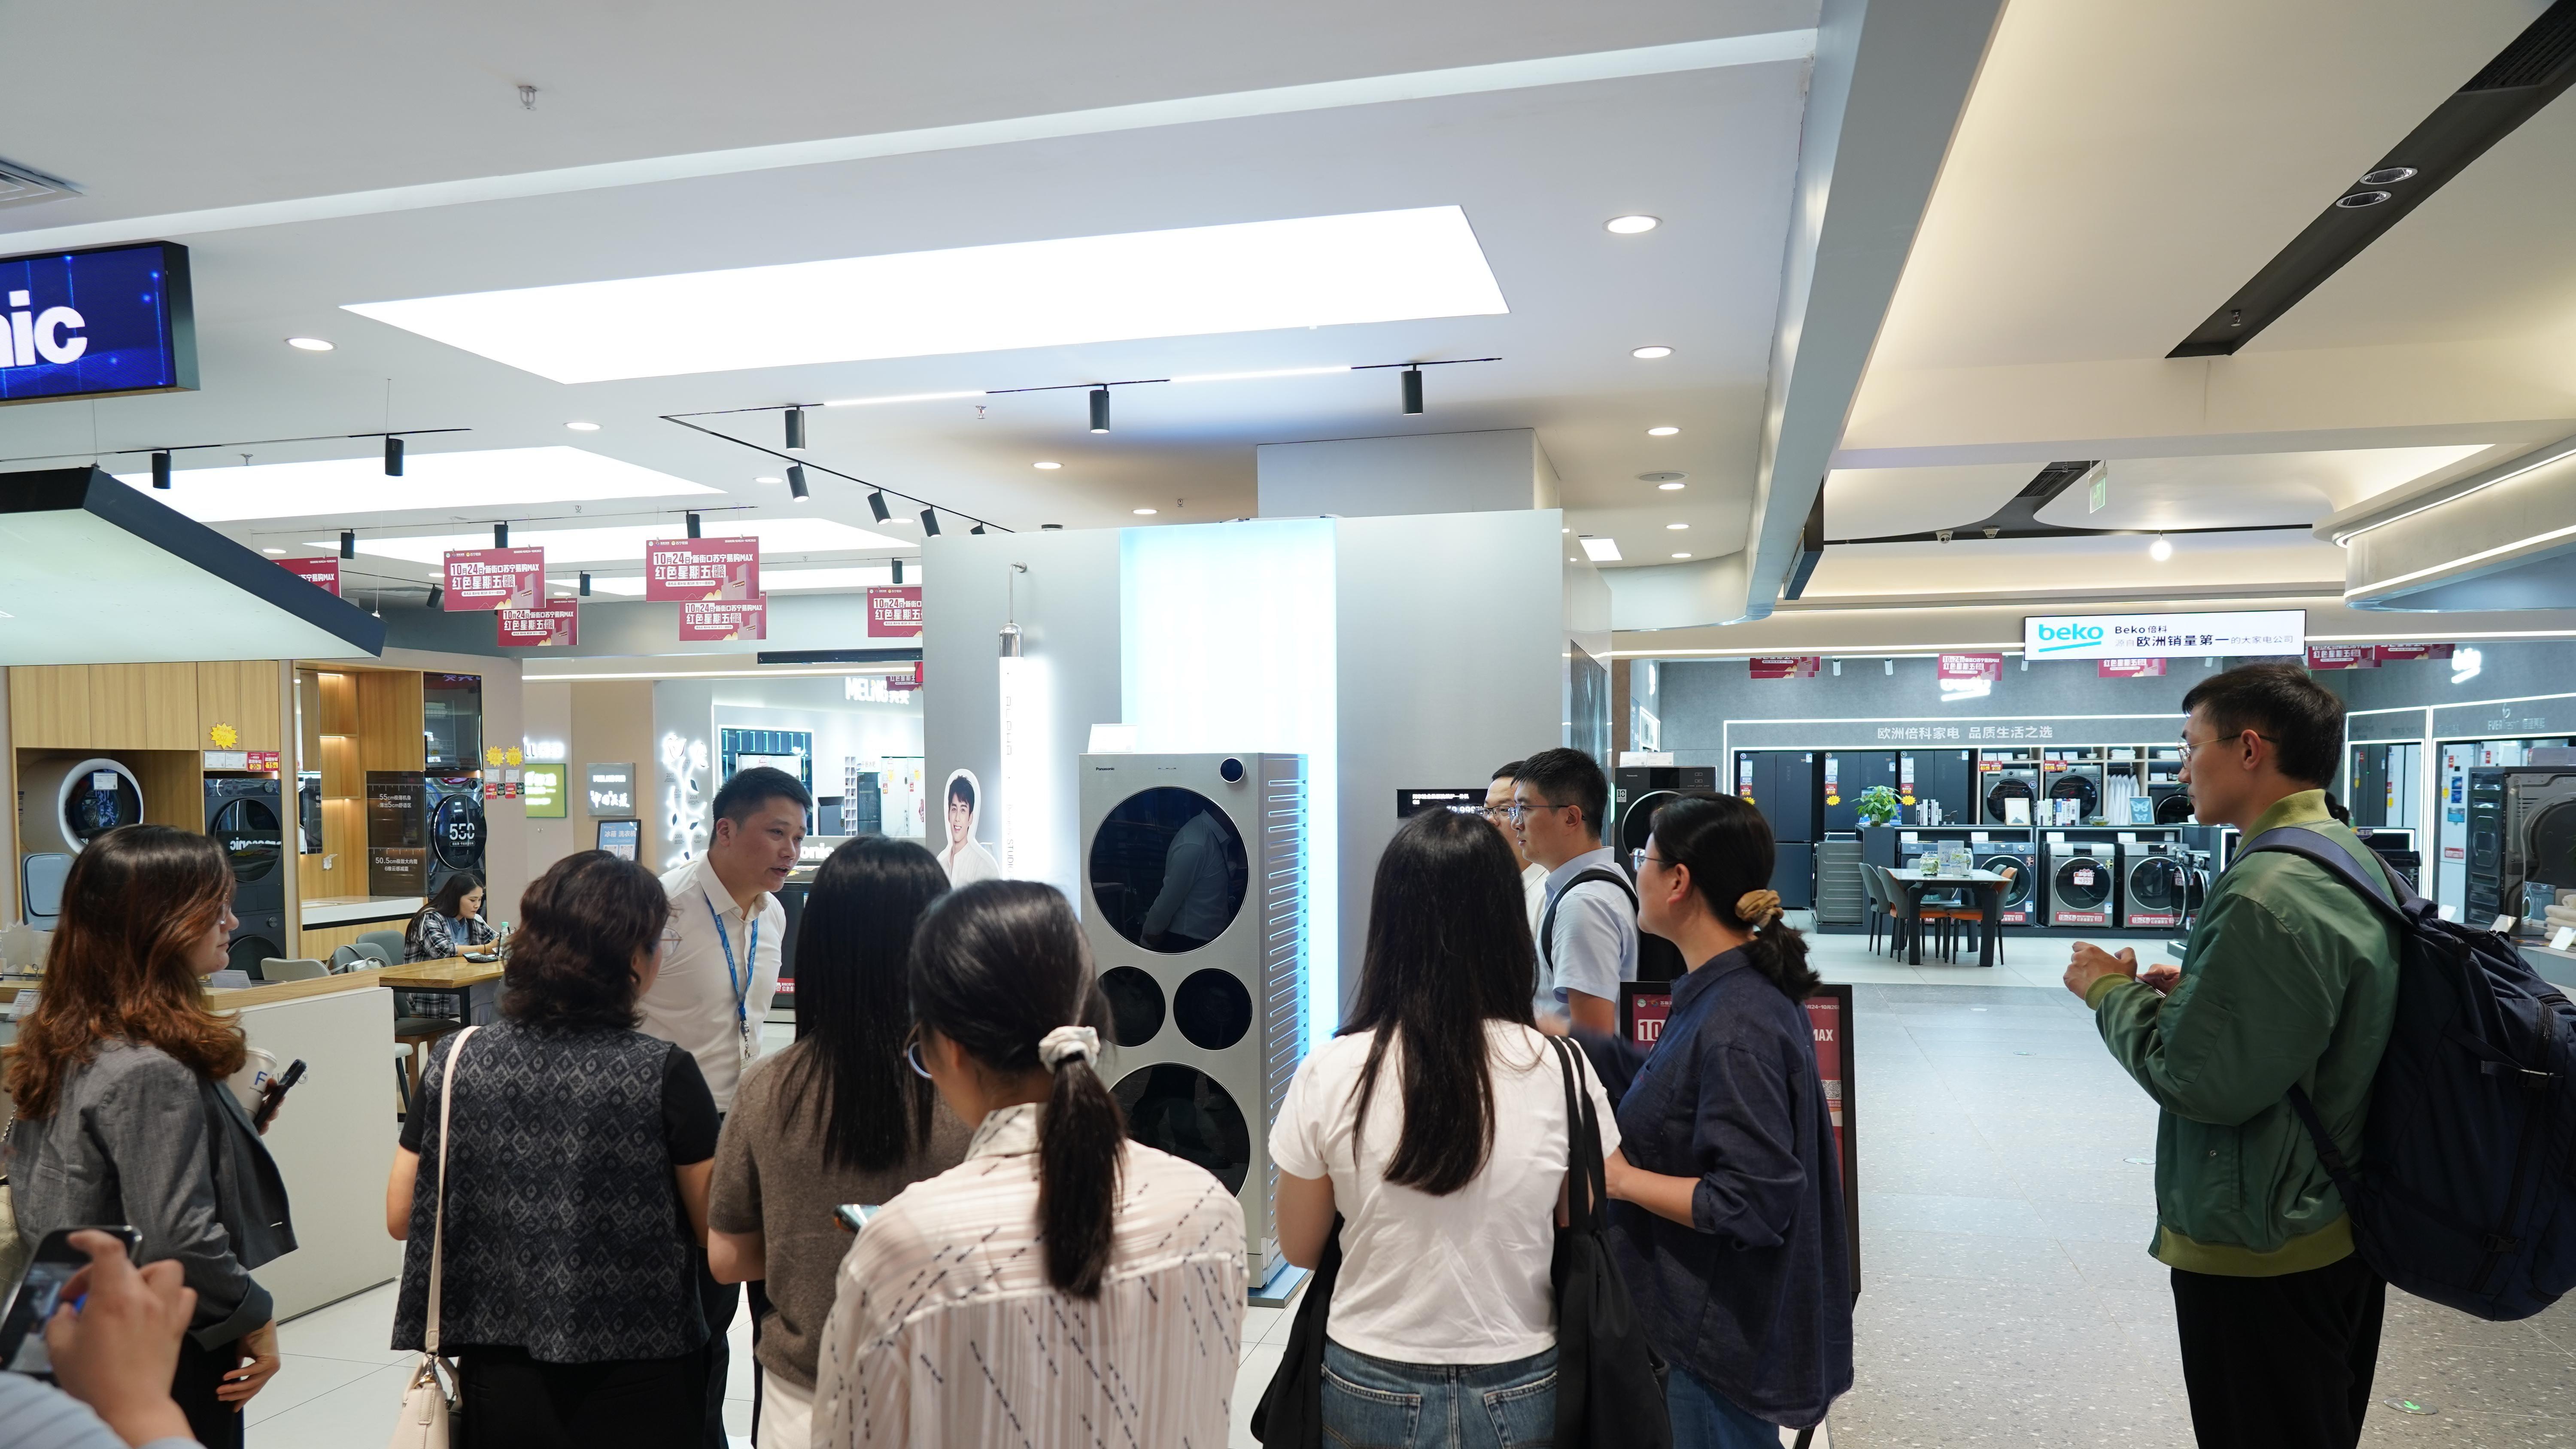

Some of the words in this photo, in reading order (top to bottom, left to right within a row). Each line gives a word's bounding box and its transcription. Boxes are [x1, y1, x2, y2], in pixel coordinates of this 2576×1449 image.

[655, 565, 711, 580] 红色星期五
[452, 576, 502, 590] 红色星期五
[687, 613, 730, 624] 红色星期五
[875, 609, 921, 620] 红色星期五
[504, 620, 544, 630] 红色星期五
[2115, 626, 2145, 634] Beko
[2148, 625, 2167, 633] 倍科
[2038, 623, 2103, 640] beko
[2115, 635, 2293, 647] 源自欧洲销量第一的大家电公司
[1877, 727, 1960, 739] 欧洲倍科家电
[1969, 726, 2052, 738] 品质生活之选
